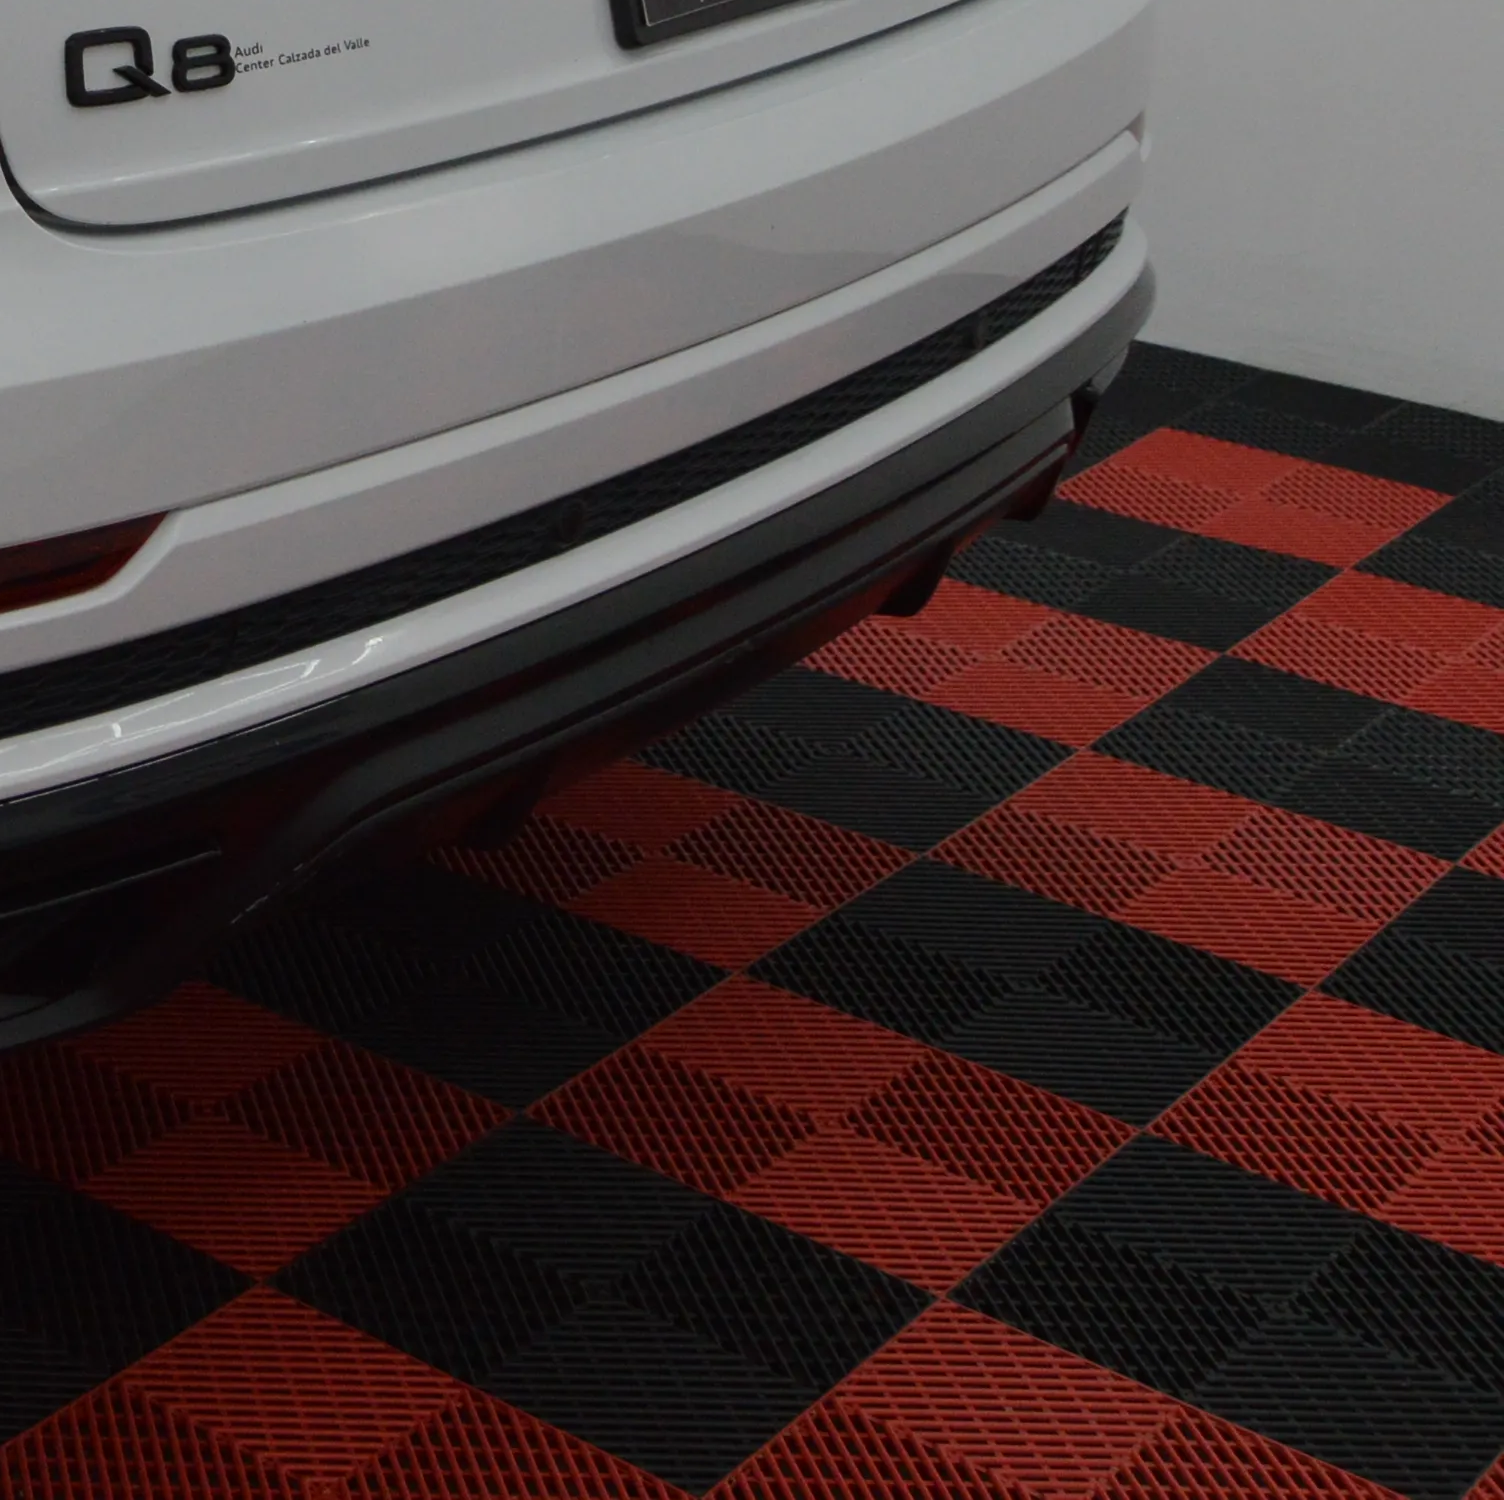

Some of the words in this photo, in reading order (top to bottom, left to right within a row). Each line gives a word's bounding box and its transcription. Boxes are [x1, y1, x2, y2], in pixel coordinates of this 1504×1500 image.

[64, 25, 236, 108] Q8
[234, 41, 264, 59] Audi
[235, 58, 275, 74] Center
[278, 48, 322, 66] Calzada
[323, 42, 342, 57] del
[344, 37, 371, 51] Valle
